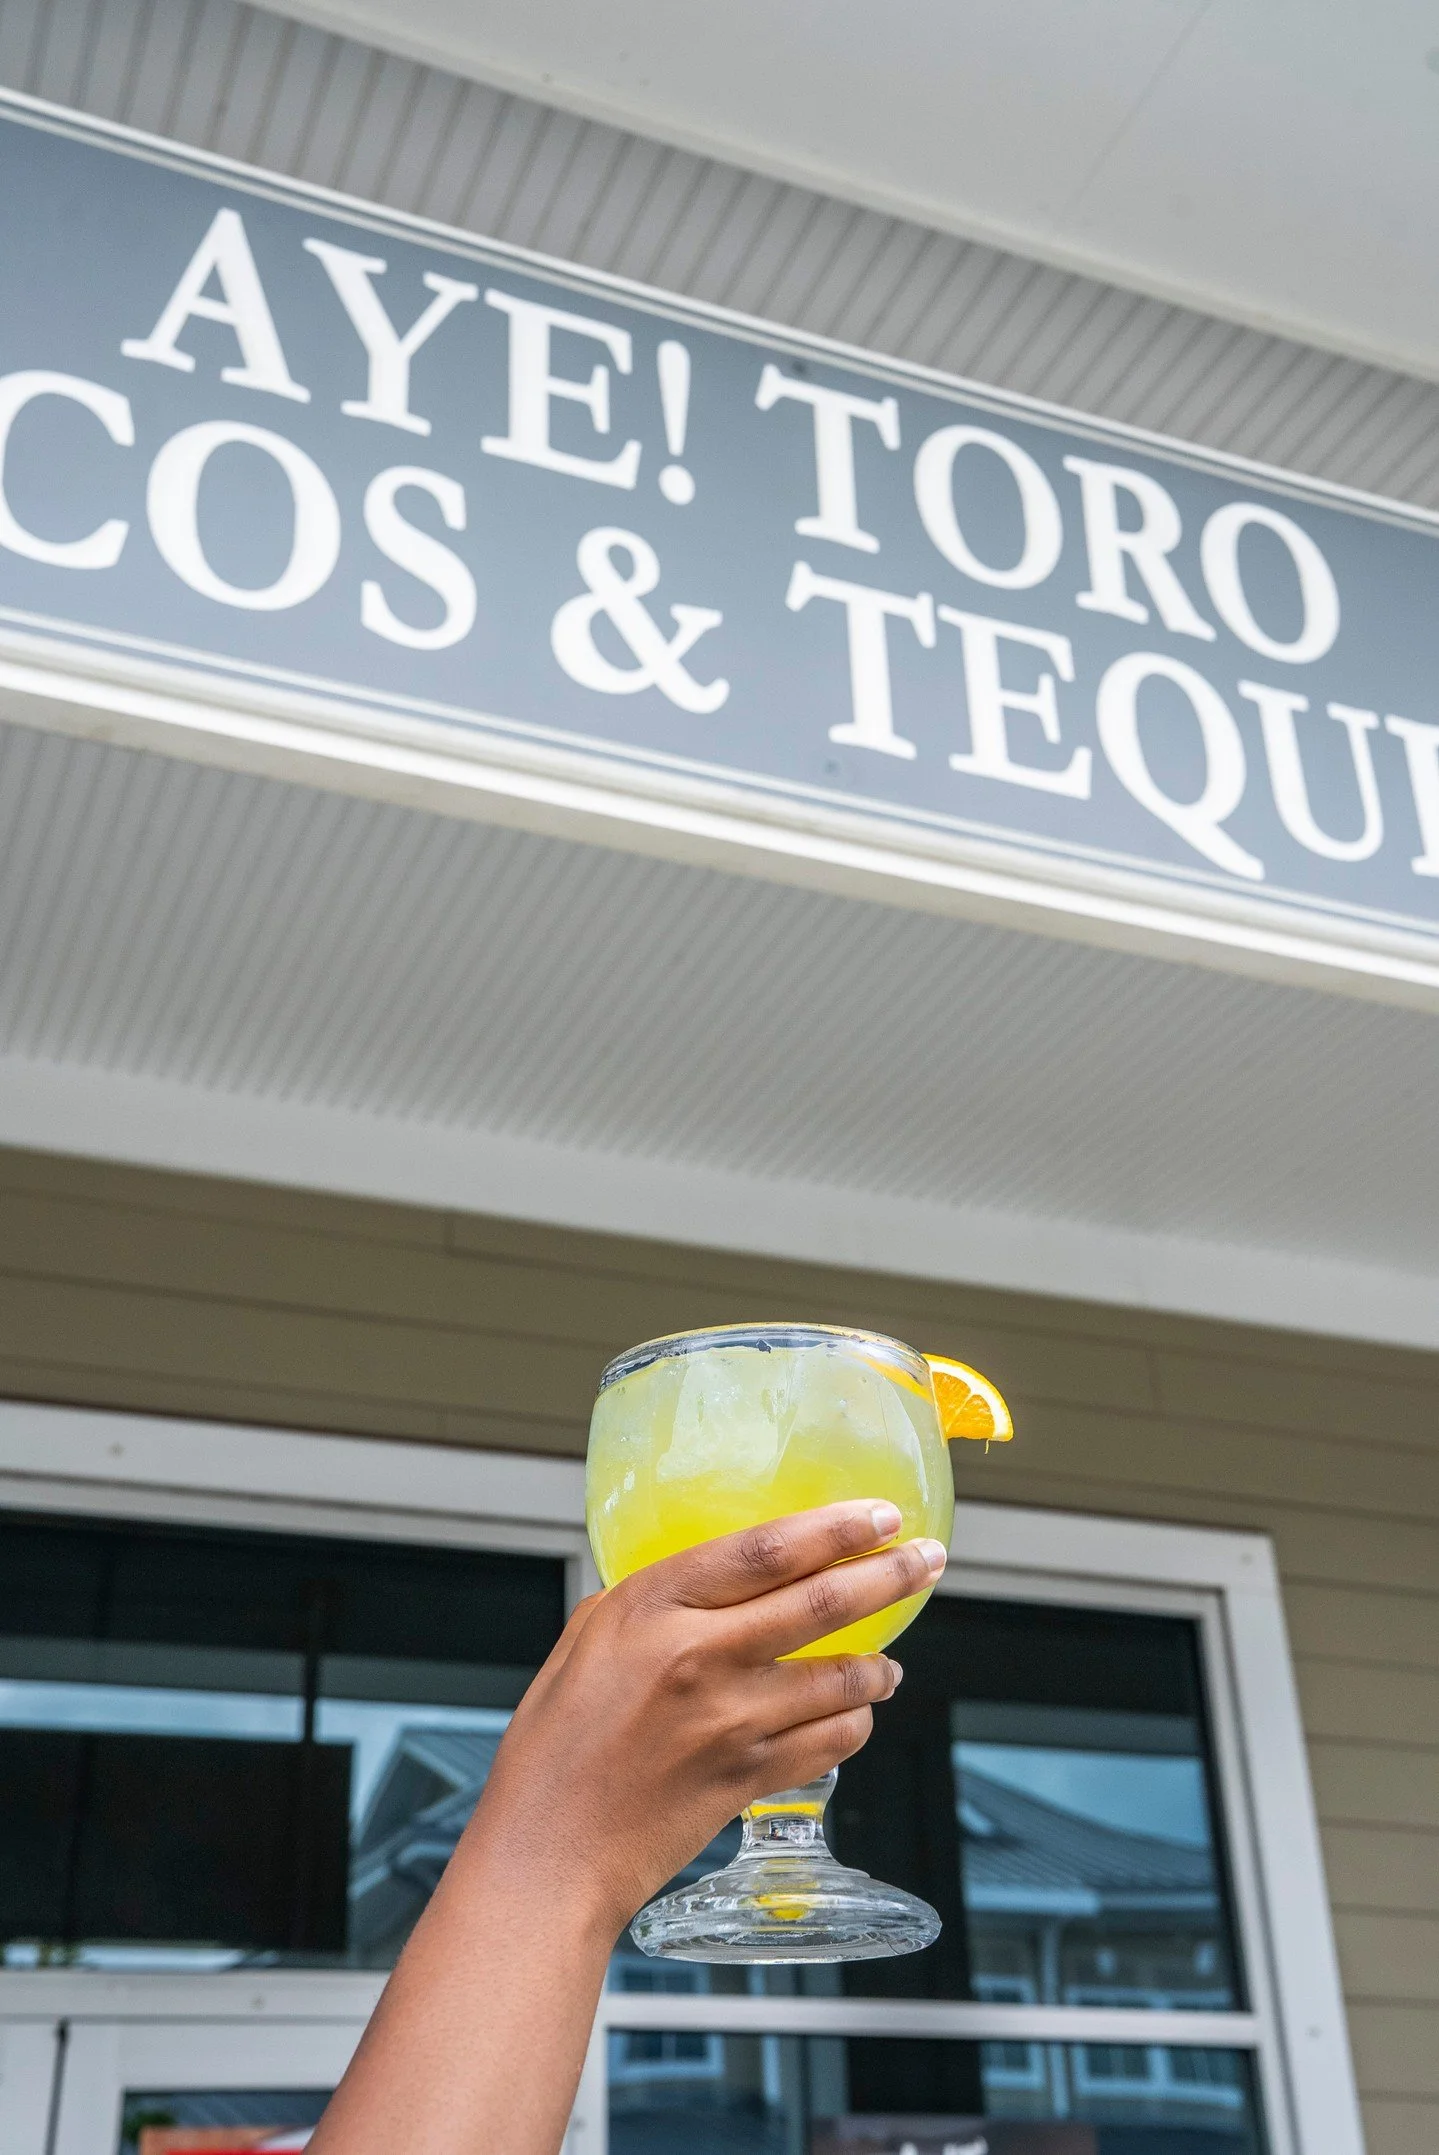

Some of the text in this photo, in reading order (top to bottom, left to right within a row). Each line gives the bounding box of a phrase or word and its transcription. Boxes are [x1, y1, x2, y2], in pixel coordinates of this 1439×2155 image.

[0, 370, 478, 651] COS
[550, 526, 730, 715] &
[121, 209, 1340, 664] AYE! TORO
